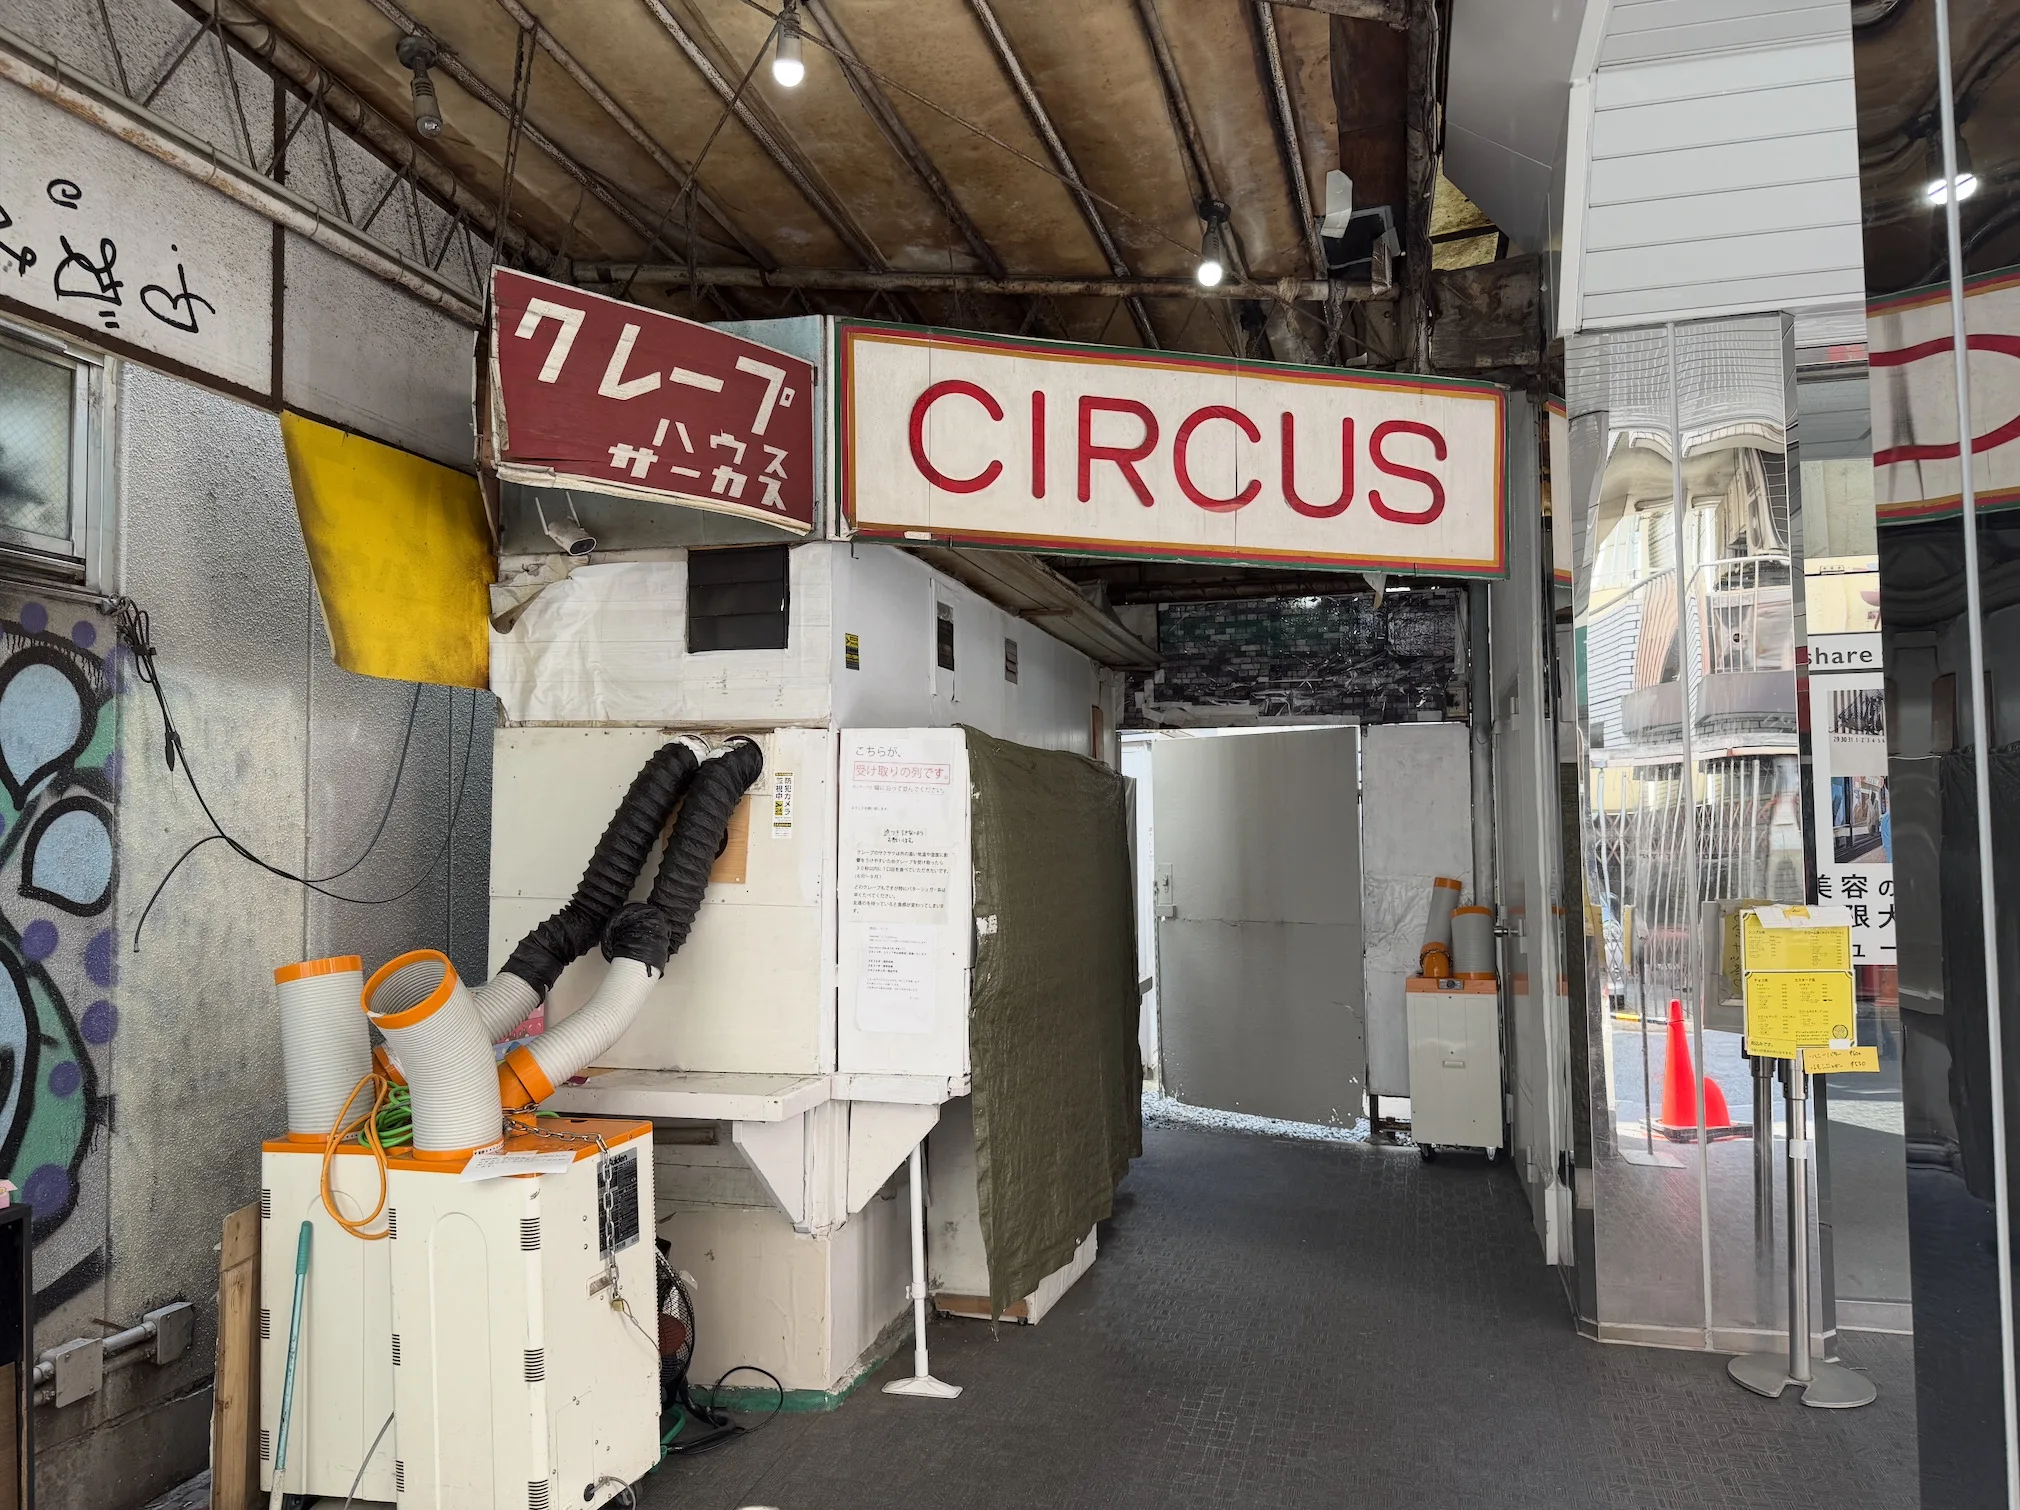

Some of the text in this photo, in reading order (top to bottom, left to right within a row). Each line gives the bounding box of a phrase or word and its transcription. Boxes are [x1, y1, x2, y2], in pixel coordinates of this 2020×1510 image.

[514, 297, 796, 437] クレープ
[607, 442, 787, 512] サーカス
[652, 417, 789, 479] ハウス
[908, 379, 1448, 526] CIRCUS
[855, 745, 902, 758] こちらが、
[855, 764, 948, 780] 受け取りの列です。
[784, 777, 792, 816] 防犯カメラ
